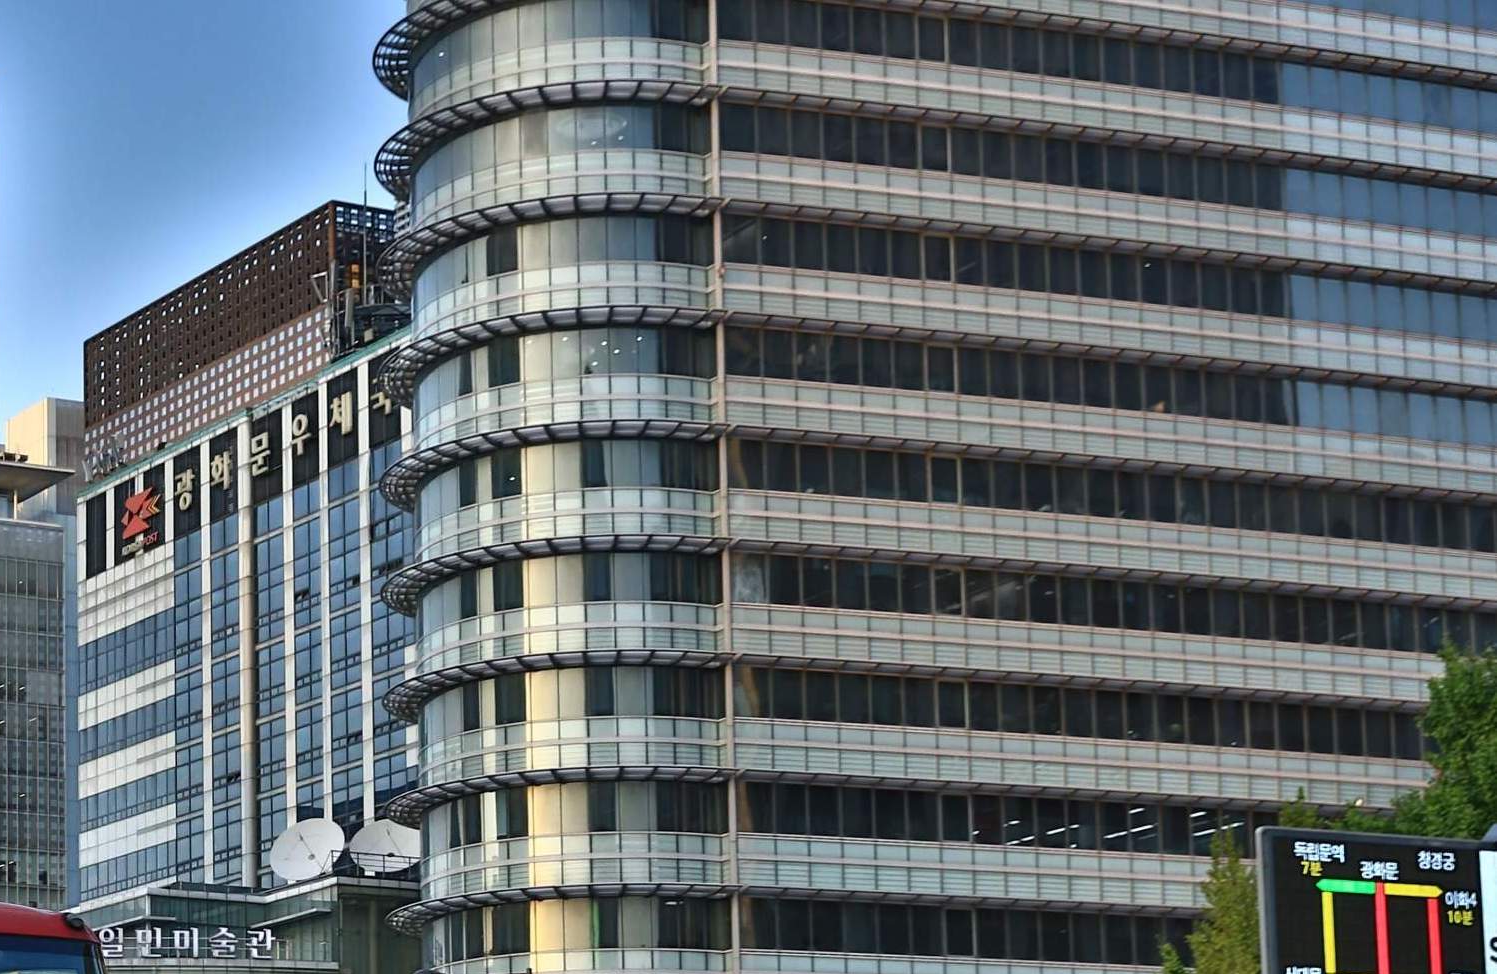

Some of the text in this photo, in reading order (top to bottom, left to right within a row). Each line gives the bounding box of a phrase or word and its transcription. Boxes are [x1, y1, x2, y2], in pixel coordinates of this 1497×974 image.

[1293, 841, 1346, 863] 독립문역
[1417, 850, 1456, 871] 창경궁
[1300, 861, 1323, 877] 7분
[1359, 860, 1400, 881] 광화문
[99, 926, 276, 960] 일민미술관
